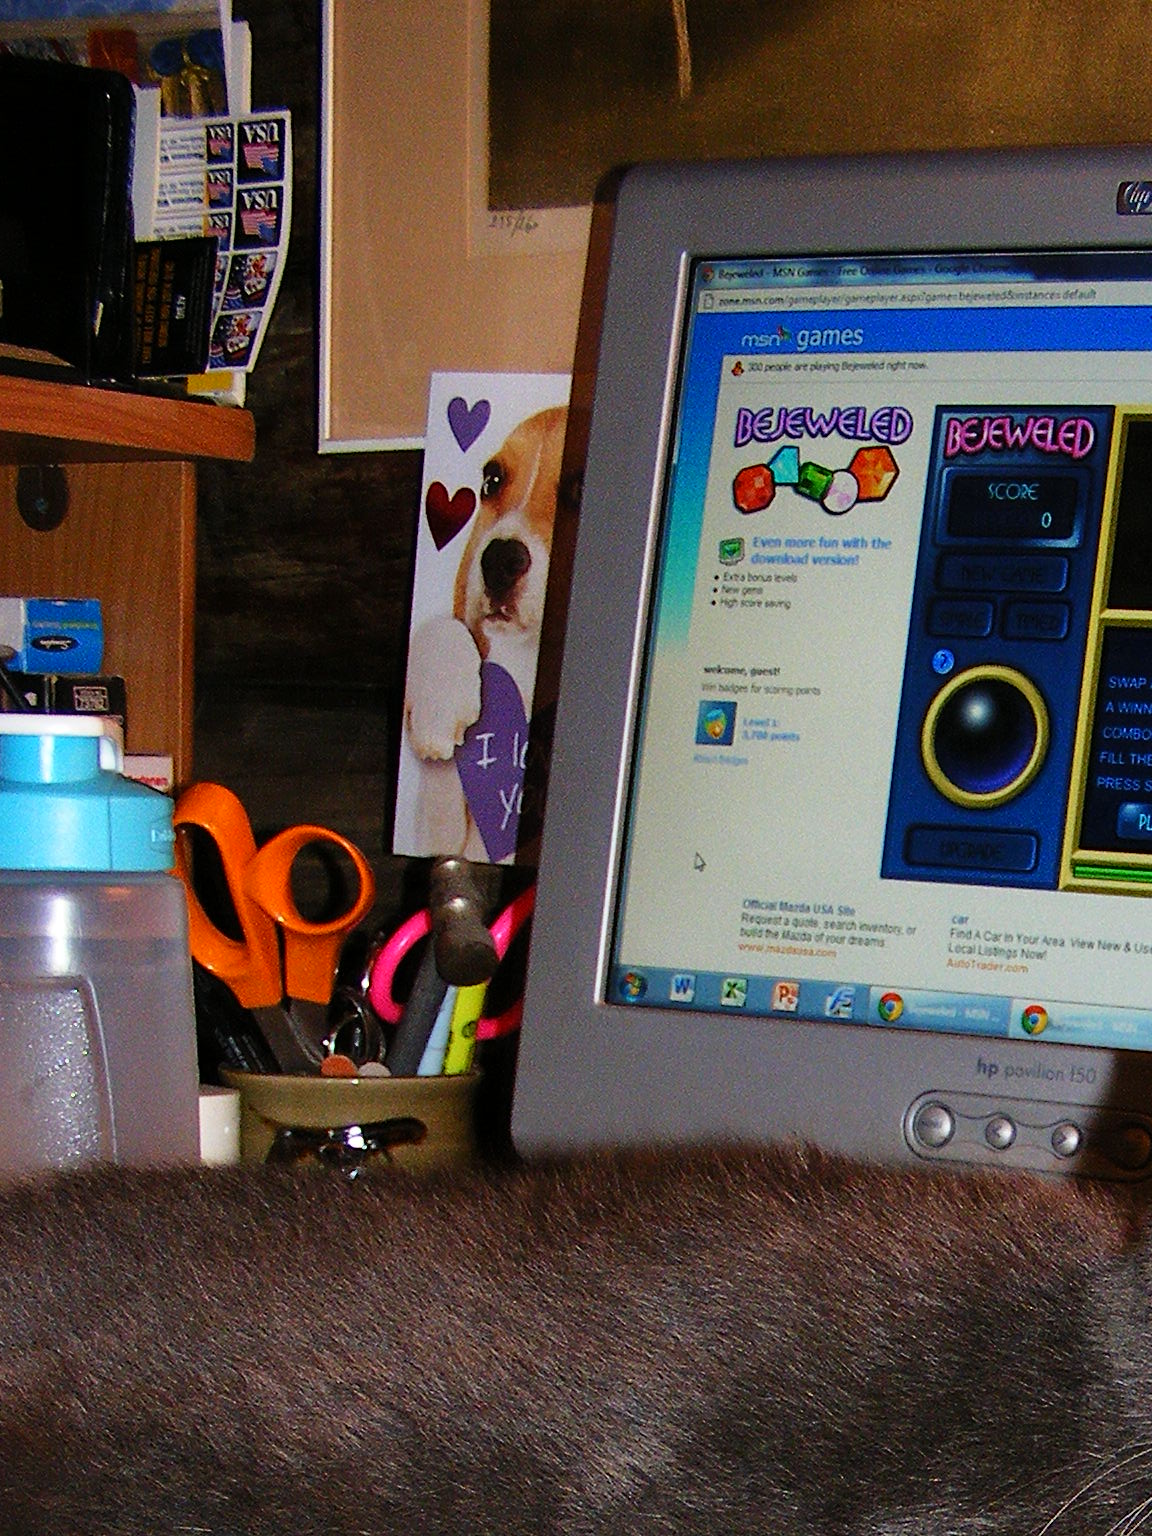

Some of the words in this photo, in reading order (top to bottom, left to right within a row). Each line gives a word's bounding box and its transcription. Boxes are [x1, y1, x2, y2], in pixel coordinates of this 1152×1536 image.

[243, 122, 279, 144] USA
[242, 189, 278, 210] USA
[741, 334, 780, 347] msn
[797, 328, 863, 350] games
[734, 406, 913, 447] BEJEWELED
[944, 415, 1095, 459] BEJEWELED
[988, 482, 1041, 500] SCORE
[1041, 511, 1052, 528] 0
[753, 536, 781, 549] Even
[785, 539, 816, 550] more
[819, 536, 839, 550] fun
[842, 537, 868, 550] with
[871, 537, 892, 550] the
[751, 553, 809, 566] download
[812, 554, 860, 566] version!
[1108, 676, 1147, 689] SWAP
[1105, 701, 1115, 713] A
[475, 732, 498, 769] I
[1099, 750, 1126, 765] FILL
[1096, 776, 1141, 792] PRESS
[779, 900, 811, 913] Mazda
[813, 903, 834, 915] USA
[951, 914, 969, 925] car
[948, 942, 976, 955] Local
[950, 927, 972, 941] Find
[974, 929, 982, 940] A
[983, 930, 1001, 943] Car
[1016, 933, 1040, 946] Your
[1071, 937, 1095, 950] View
[1097, 939, 1121, 952] New
[1124, 941, 1132, 953] &
[977, 1057, 999, 1079] hp
